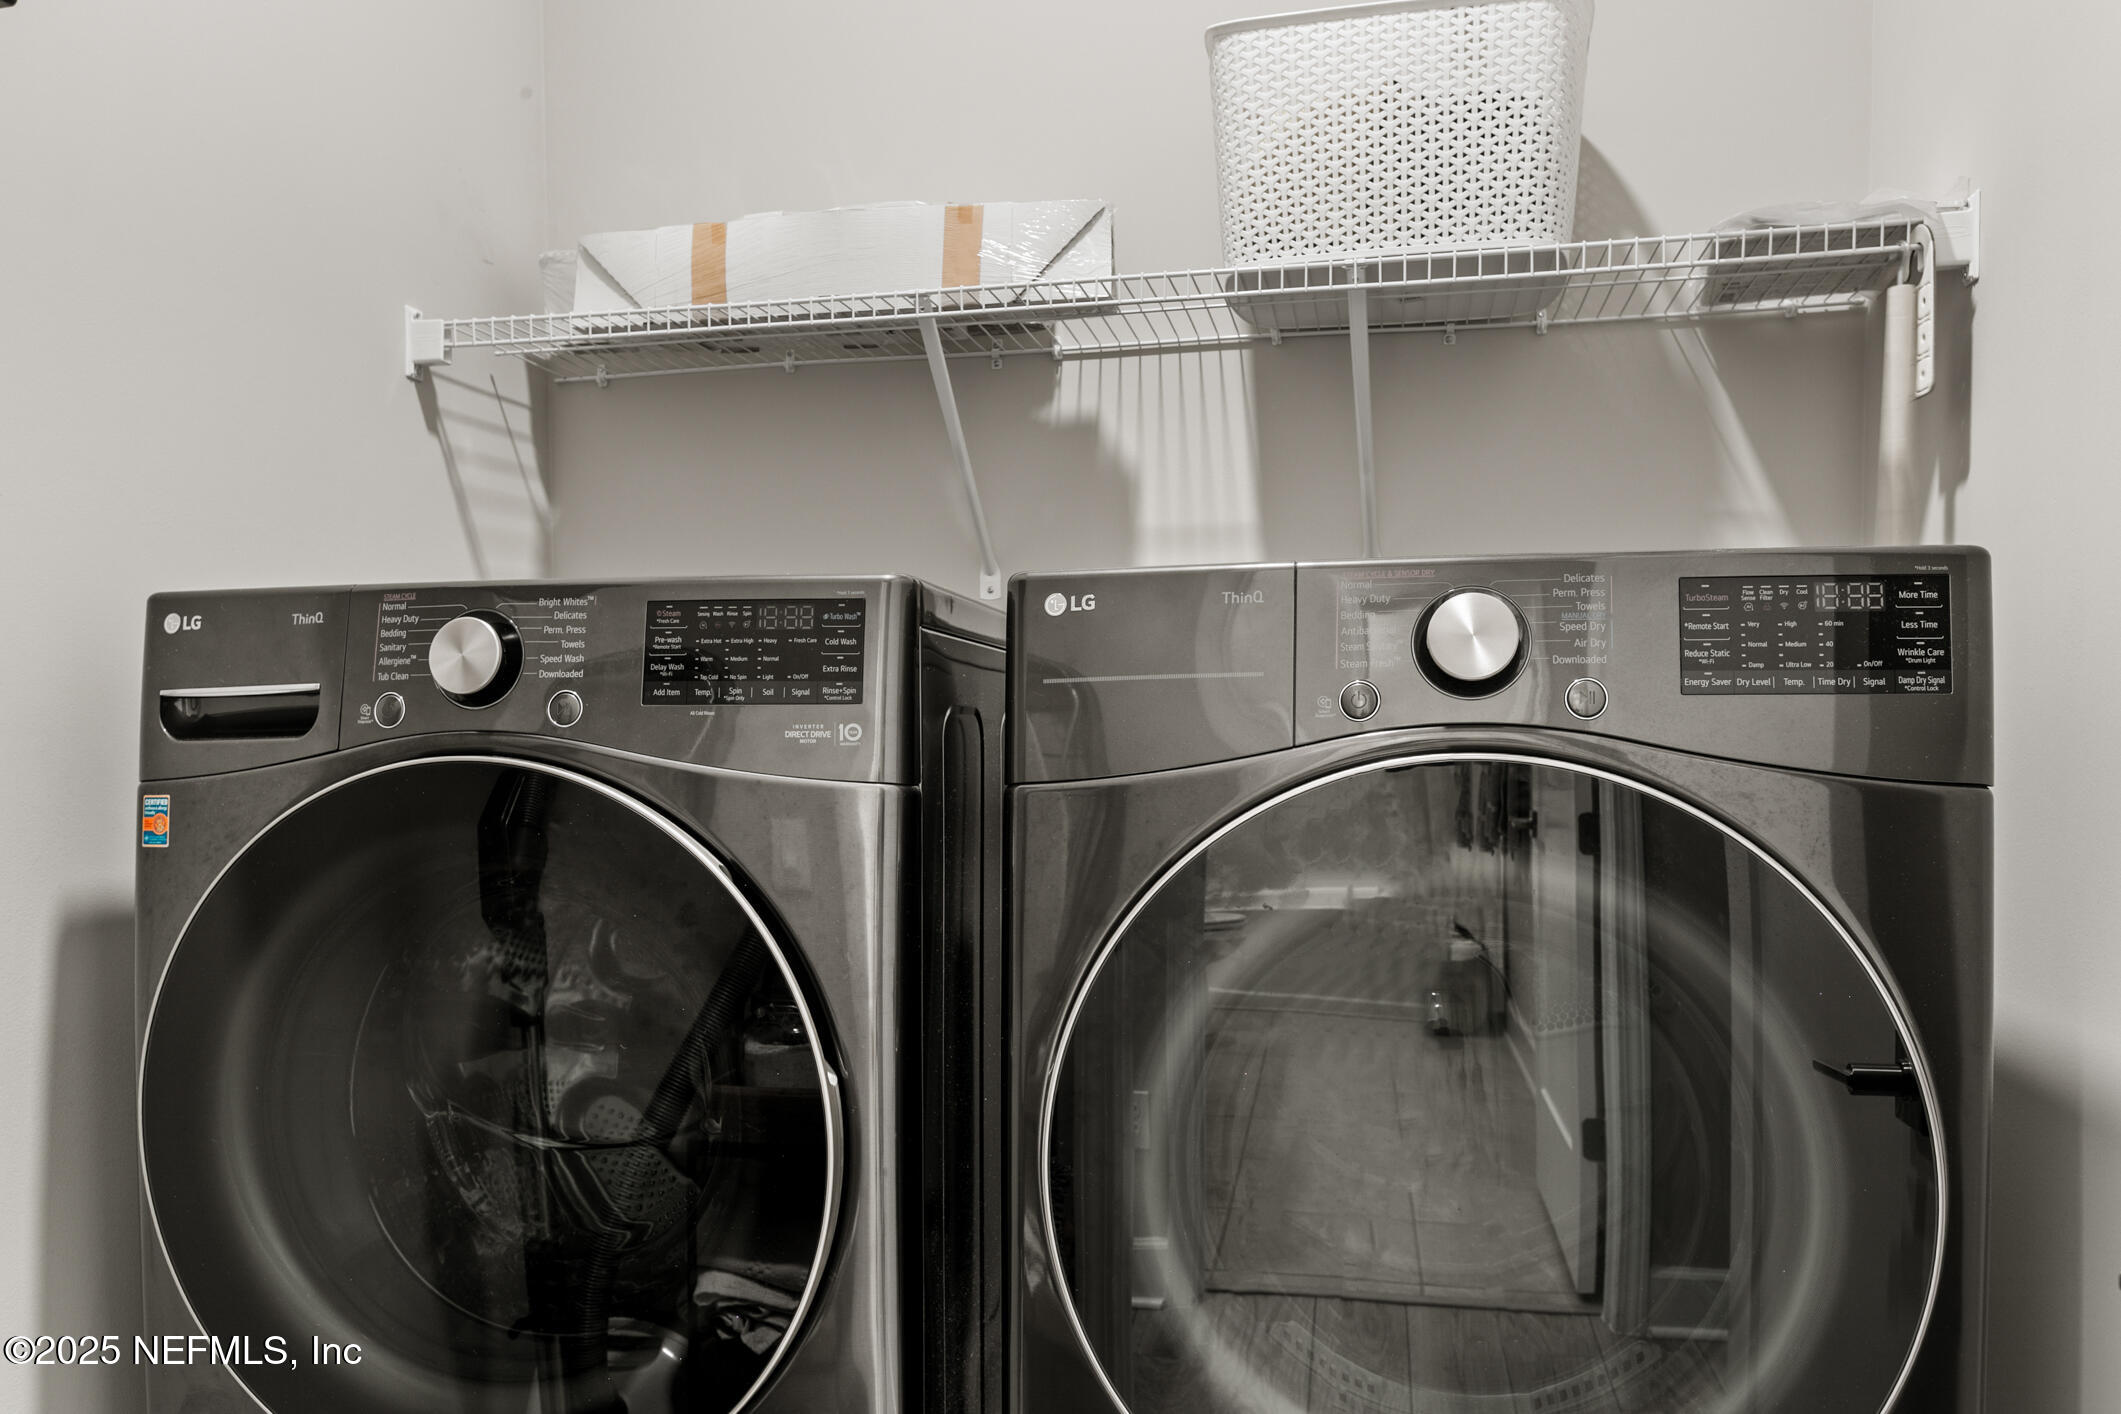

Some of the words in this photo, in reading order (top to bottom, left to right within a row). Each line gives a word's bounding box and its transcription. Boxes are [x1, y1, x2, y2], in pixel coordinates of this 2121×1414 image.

[1421, 569, 1435, 577] DRY
[1564, 573, 1605, 583] Delicates
[1341, 580, 1372, 590] Normal
[384, 593, 400, 601] STEAM
[1553, 588, 1577, 597] Perm.
[1581, 588, 1606, 597] Press
[1899, 591, 1918, 599] More
[1222, 591, 1264, 604] ThinQ
[1341, 595, 1366, 605] Heavy
[1370, 594, 1391, 605] Duty
[382, 602, 406, 610] Normal
[539, 598, 561, 608] Bright
[1070, 594, 1096, 611] LG
[1576, 602, 1606, 610] Towels
[292, 612, 324, 625] ThinQ
[381, 616, 402, 625] Heavy
[403, 615, 419, 624] Duty
[554, 611, 587, 620] Delicates
[182, 615, 202, 631] LG
[1560, 622, 1586, 632] Speed
[1590, 622, 1606, 632] Dry
[380, 629, 406, 638] Bedding
[544, 626, 563, 634] Perm.
[566, 625, 586, 633] Press
[380, 643, 406, 653] Sanitary
[561, 640, 585, 648] Towels
[1340, 643, 1364, 652] Steam
[1574, 639, 1586, 647] Air
[1590, 639, 1606, 648] Dry
[1710, 649, 1730, 657] Static
[1898, 648, 1925, 656] Wrinkle
[1927, 648, 1945, 656] Care
[540, 654, 562, 664] Speed
[565, 654, 584, 662] Wash
[1553, 655, 1607, 664] Downloaded
[1340, 660, 1367, 669] Steam
[378, 672, 389, 680] Tub
[391, 672, 409, 680] Clean
[539, 670, 583, 678] Downloaded
[1684, 678, 1709, 687] Energy
[1711, 678, 1731, 686] Saver
[1737, 678, 1749, 687] Dry
[1752, 678, 1771, 686] Level
[1784, 678, 1805, 687] Temp.
[1838, 678, 1851, 687] Dry
[1863, 678, 1886, 687] Signal
[1898, 676, 1916, 685] Damp
[1918, 676, 1927, 684] Dry
[1928, 676, 1945, 684] Signal
[695, 689, 712, 698] Temp.
[729, 687, 742, 695] Spin
[792, 688, 810, 697] Signal
[839, 723, 862, 741] 10
